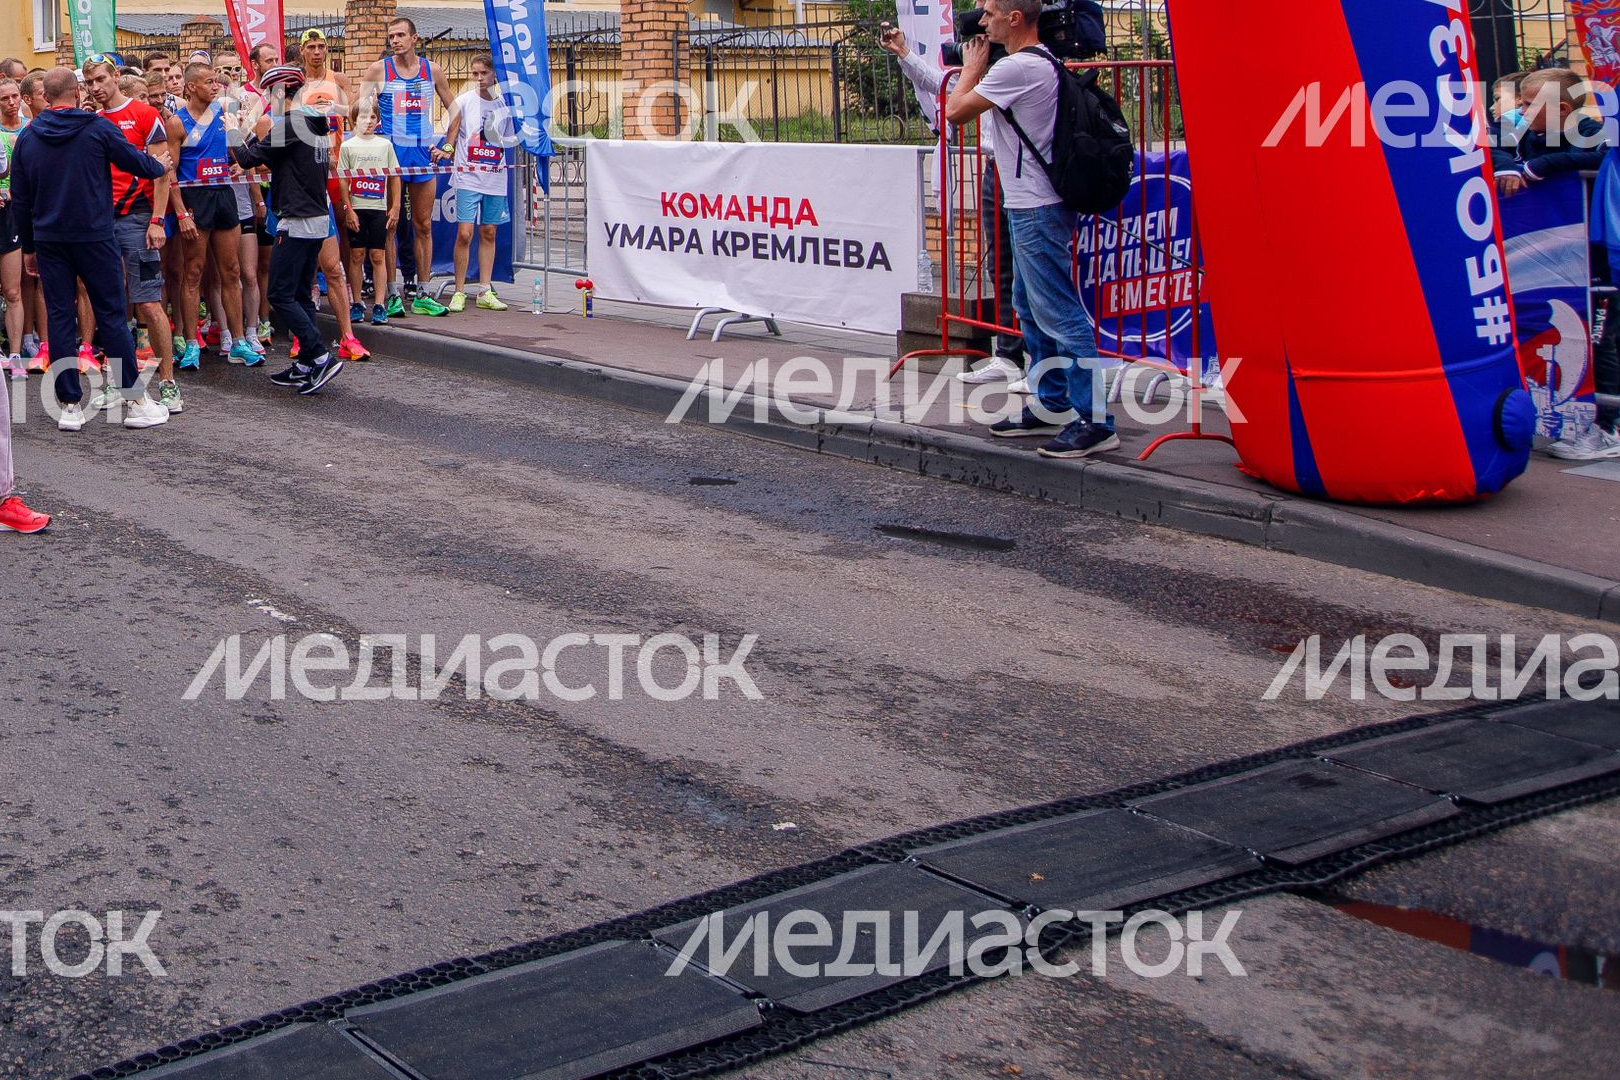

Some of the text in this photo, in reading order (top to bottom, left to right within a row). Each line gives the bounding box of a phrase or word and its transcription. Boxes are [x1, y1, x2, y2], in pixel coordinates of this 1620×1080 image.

[473, 149, 496, 158] 5689
[202, 166, 223, 176] 5933
[356, 181, 381, 191] 6002
[661, 191, 818, 229] КОМАНДА
[1068, 208, 1178, 254] АБОТАЕМ
[604, 221, 892, 272] УМАРА КРЕМЛЕВА
